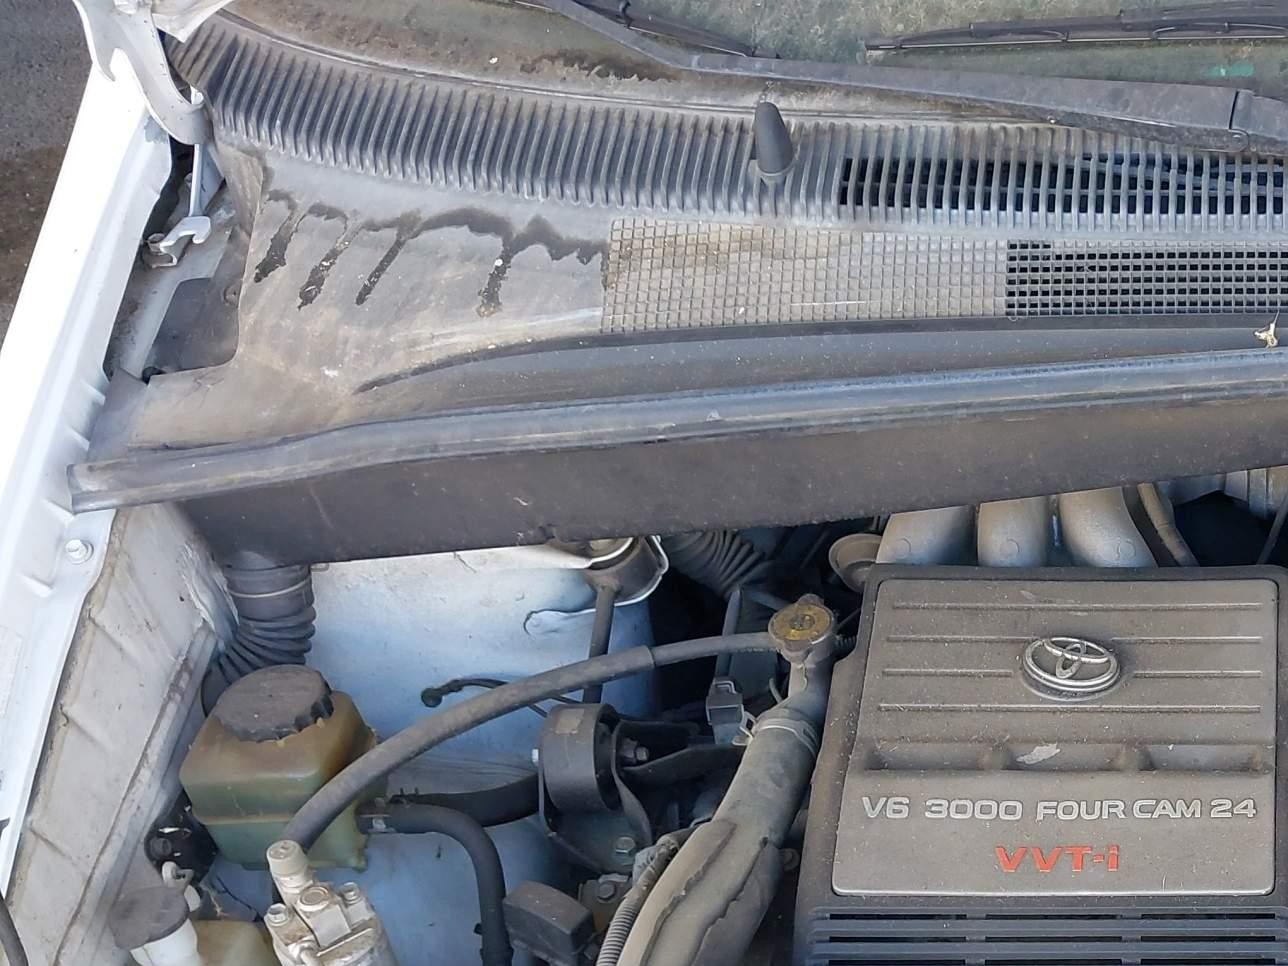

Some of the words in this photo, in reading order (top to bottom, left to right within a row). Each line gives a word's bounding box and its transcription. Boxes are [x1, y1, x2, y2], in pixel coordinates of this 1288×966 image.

[862, 796, 910, 819] V6
[924, 799, 1023, 821] 3000
[1036, 799, 1127, 821] FOUR
[1132, 799, 1201, 819] CAM
[1210, 798, 1257, 819] 24
[995, 844, 1120, 873] VVT-i
